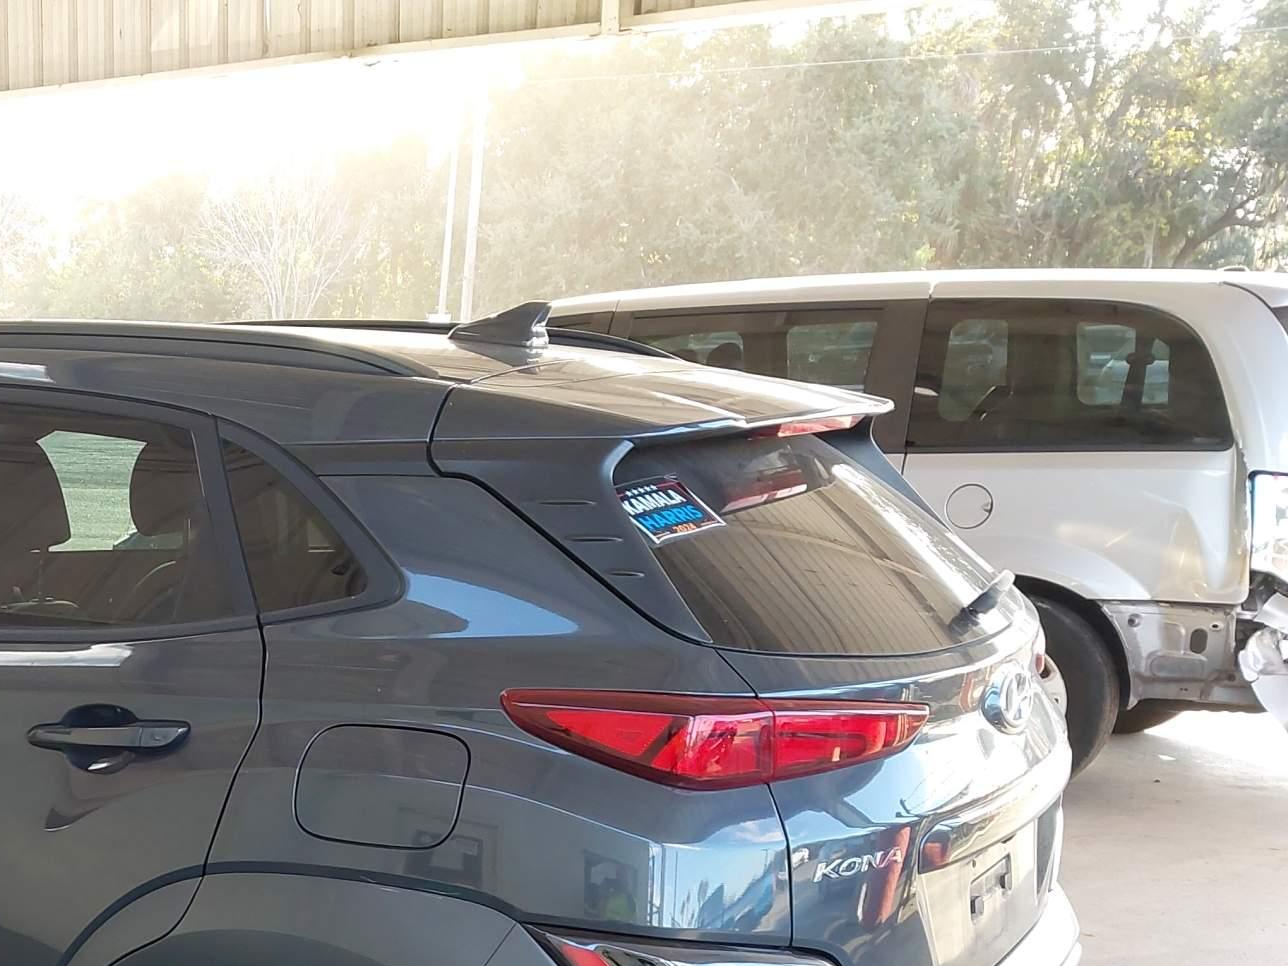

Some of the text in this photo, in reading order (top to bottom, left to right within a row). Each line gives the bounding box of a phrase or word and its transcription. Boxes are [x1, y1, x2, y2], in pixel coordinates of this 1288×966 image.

[622, 489, 687, 515] KAMALA
[637, 504, 704, 532] HARRIS
[671, 522, 697, 533] 2024
[813, 847, 902, 883] KONA
